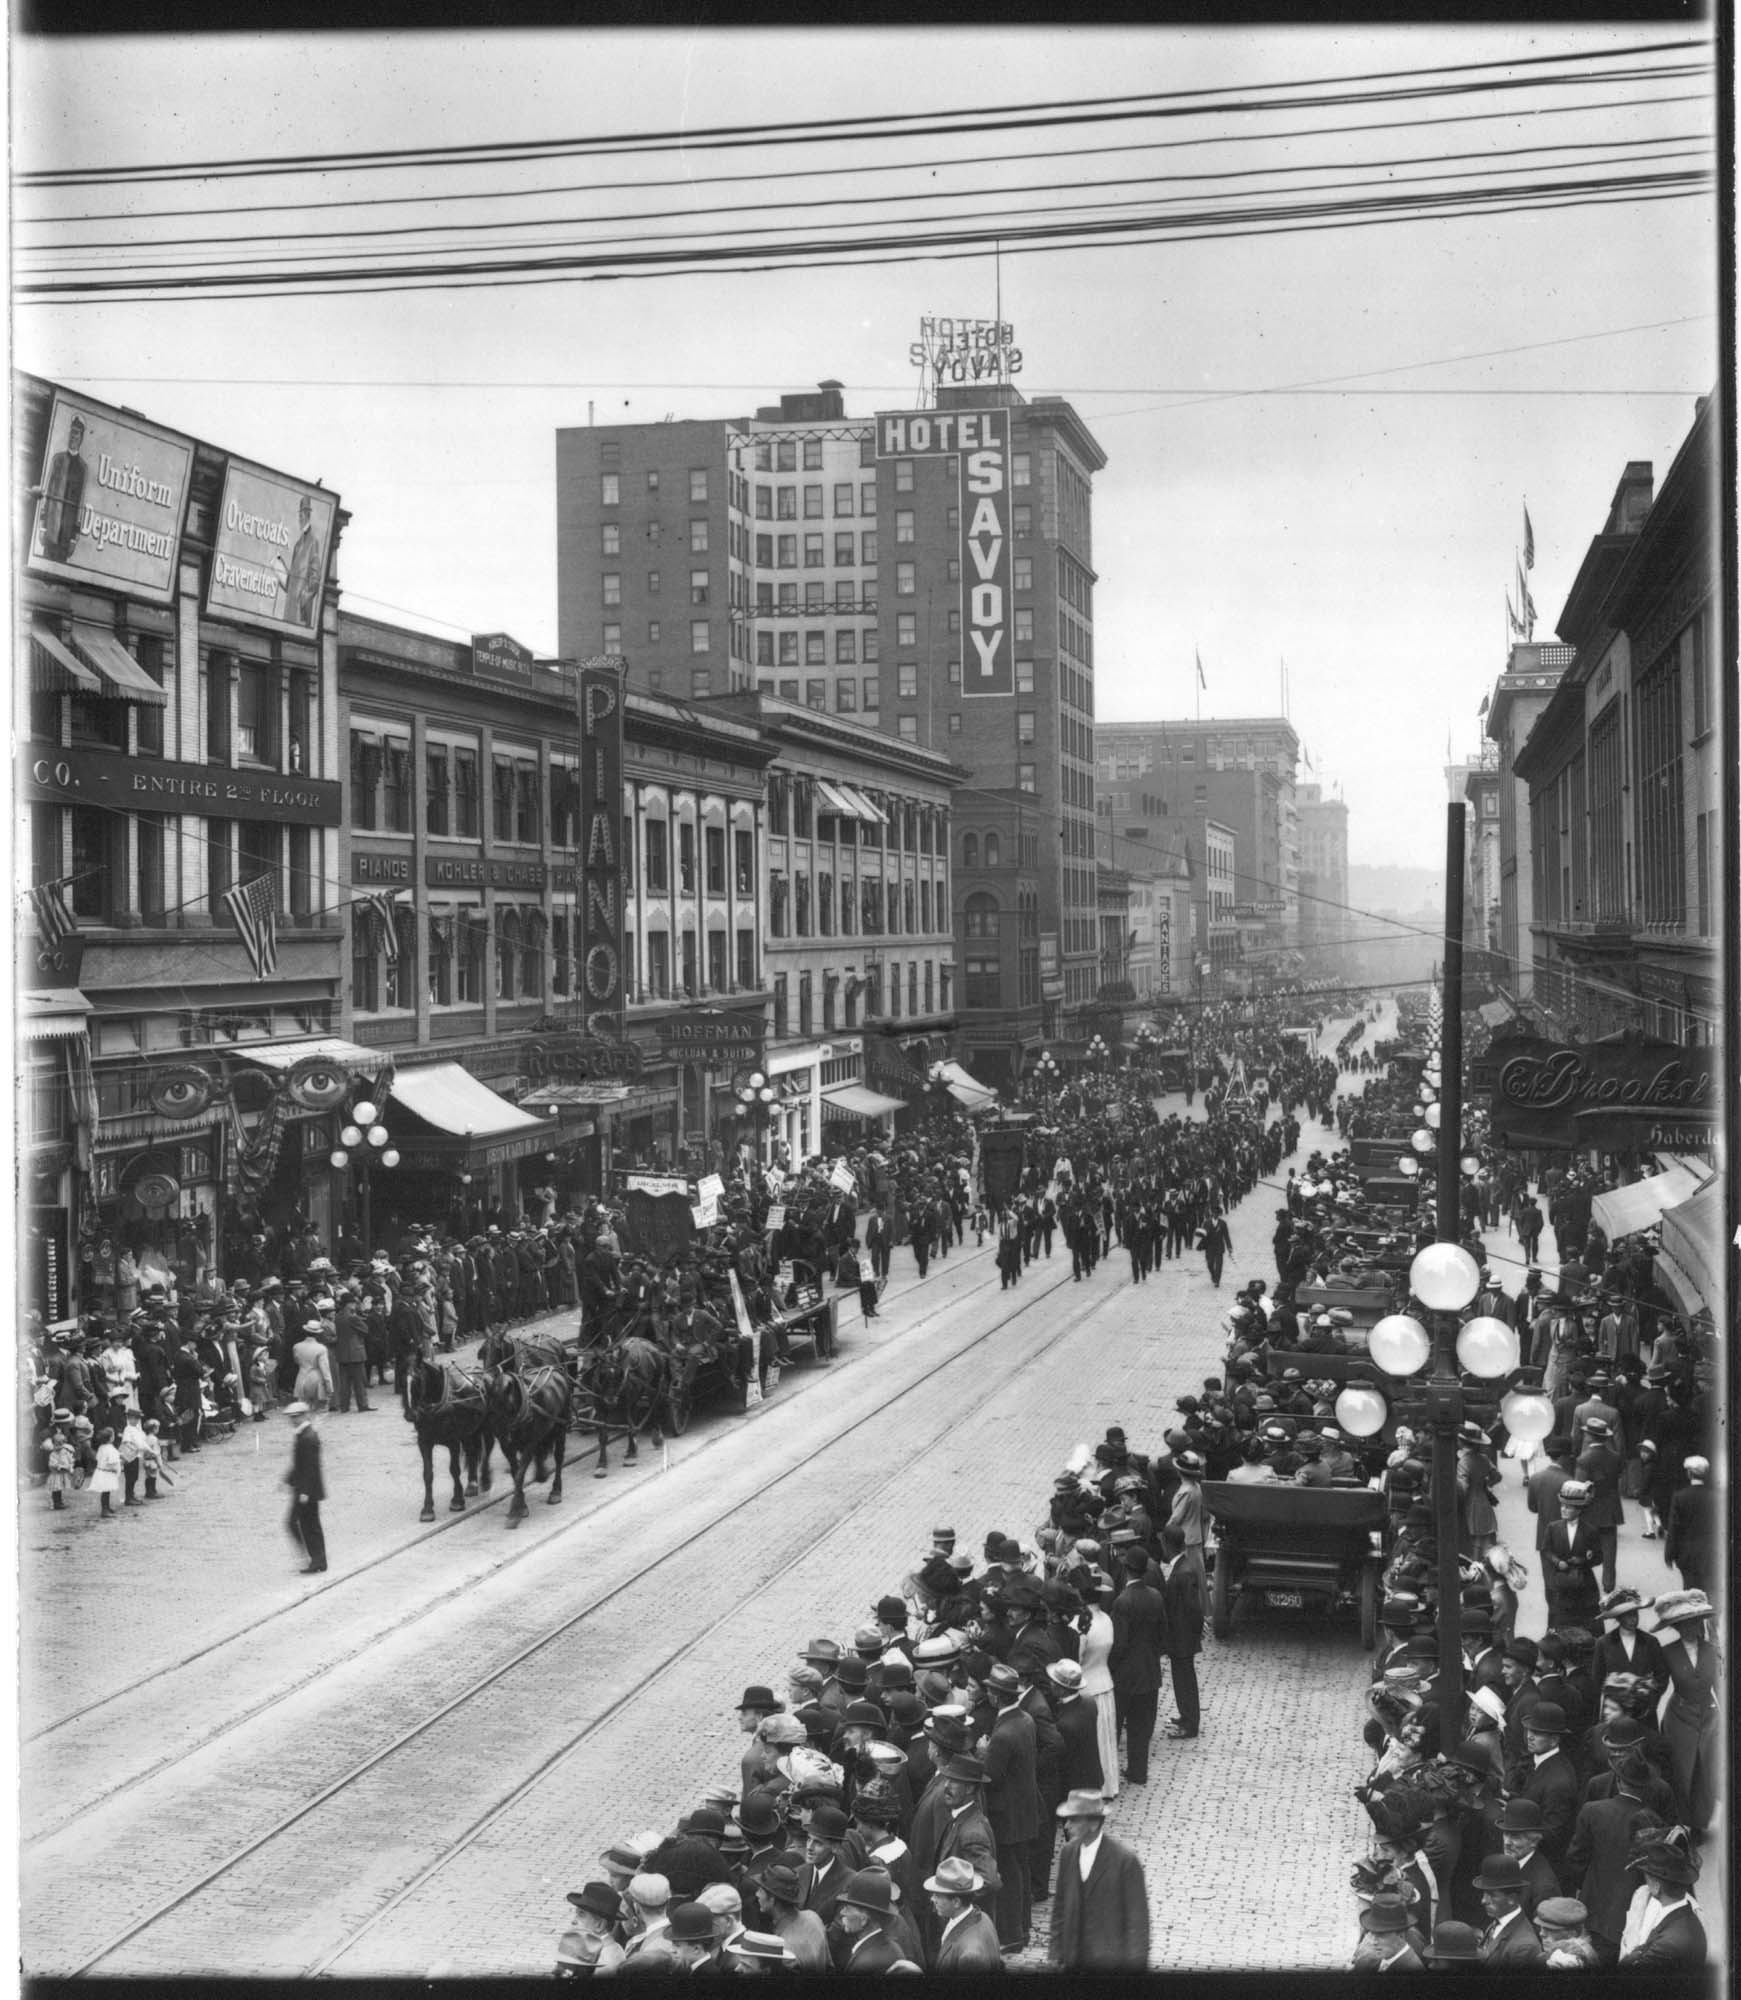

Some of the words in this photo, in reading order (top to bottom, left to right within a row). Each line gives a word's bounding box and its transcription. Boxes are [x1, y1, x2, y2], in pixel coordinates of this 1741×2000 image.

[884, 414, 1001, 453] HOTEL
[98, 452, 173, 509] Uniform
[80, 502, 174, 560] Department
[225, 499, 290, 547] Overcoats
[214, 553, 278, 600] Cravenettes
[967, 450, 1004, 677] SAVOY
[33, 759, 81, 787] CO.
[133, 774, 217, 797] ENTIRE
[260, 787, 321, 808] FLOOR
[359, 857, 409, 878] PIANOS
[437, 861, 484, 880] KOHLER
[506, 864, 543, 882] CHASE
[586, 683, 617, 1047] PIANOS
[1160, 913, 1169, 993] PANTAGES
[671, 1024, 752, 1040] HOFFMAN
